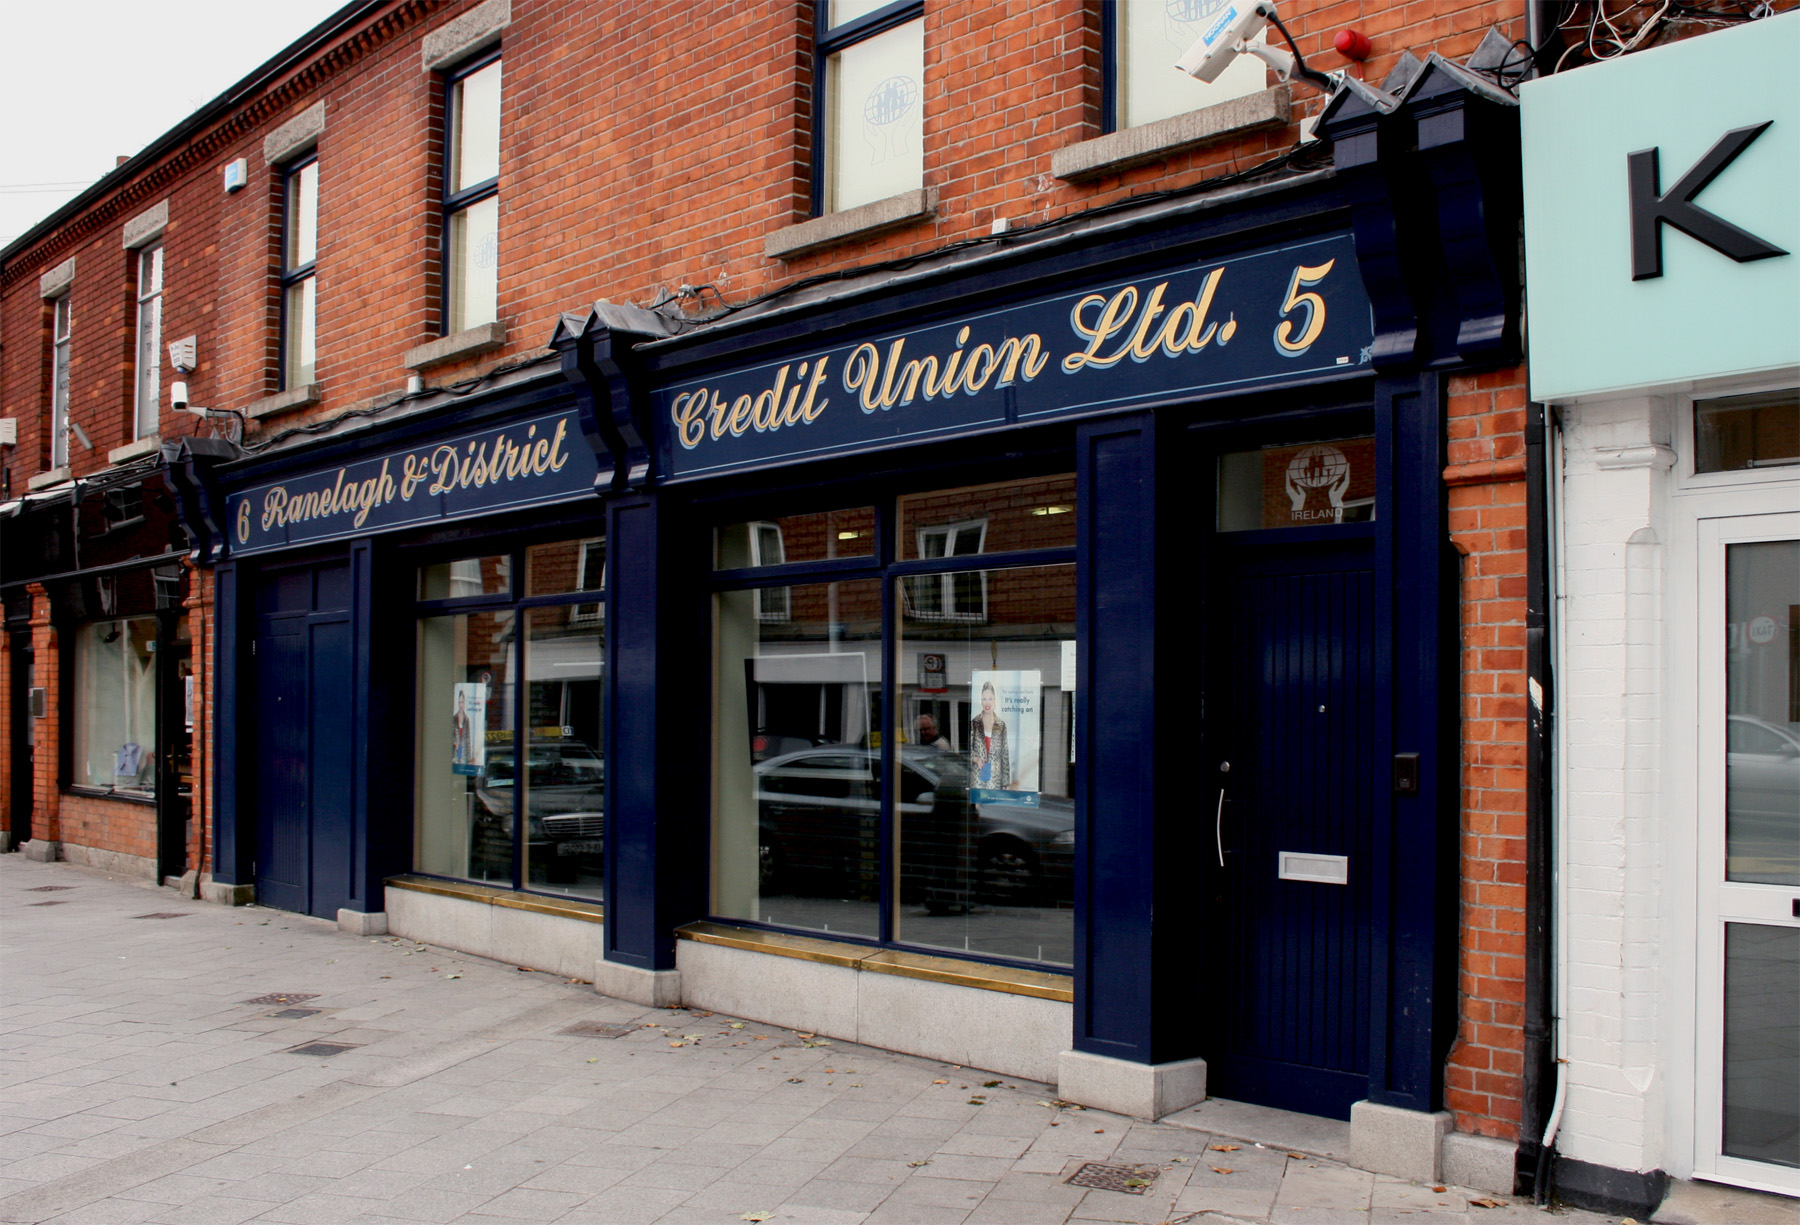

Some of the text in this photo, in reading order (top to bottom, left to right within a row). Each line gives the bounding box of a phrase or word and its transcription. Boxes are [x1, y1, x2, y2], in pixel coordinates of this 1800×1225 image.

[1205, 9, 1233, 41] NOONAN
[1627, 119, 1791, 282] K
[671, 257, 1336, 451] Credit Union Ltd. 5
[236, 417, 569, 544] 6 Ranelagh & District
[1291, 507, 1343, 521] IRELAND
[1001, 705, 1025, 714] catching
[1004, 696, 1031, 705] It's really
